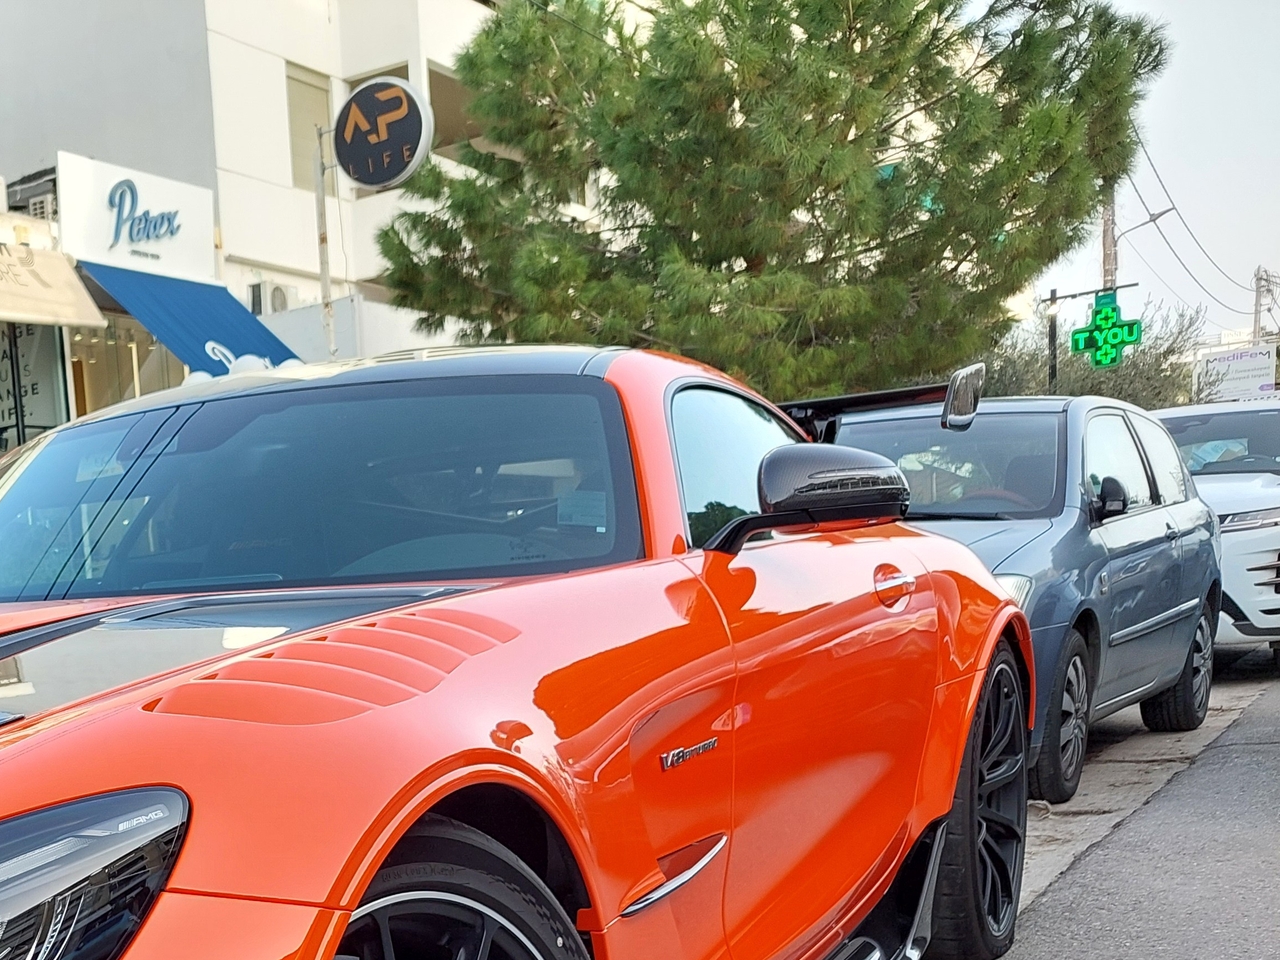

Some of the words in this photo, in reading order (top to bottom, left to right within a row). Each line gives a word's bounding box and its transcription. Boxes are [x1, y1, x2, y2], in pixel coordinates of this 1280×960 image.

[343, 86, 409, 145] AP
[349, 145, 413, 179] LIFE
[1093, 323, 1138, 346] YOU
[133, 810, 164, 827] AMG
